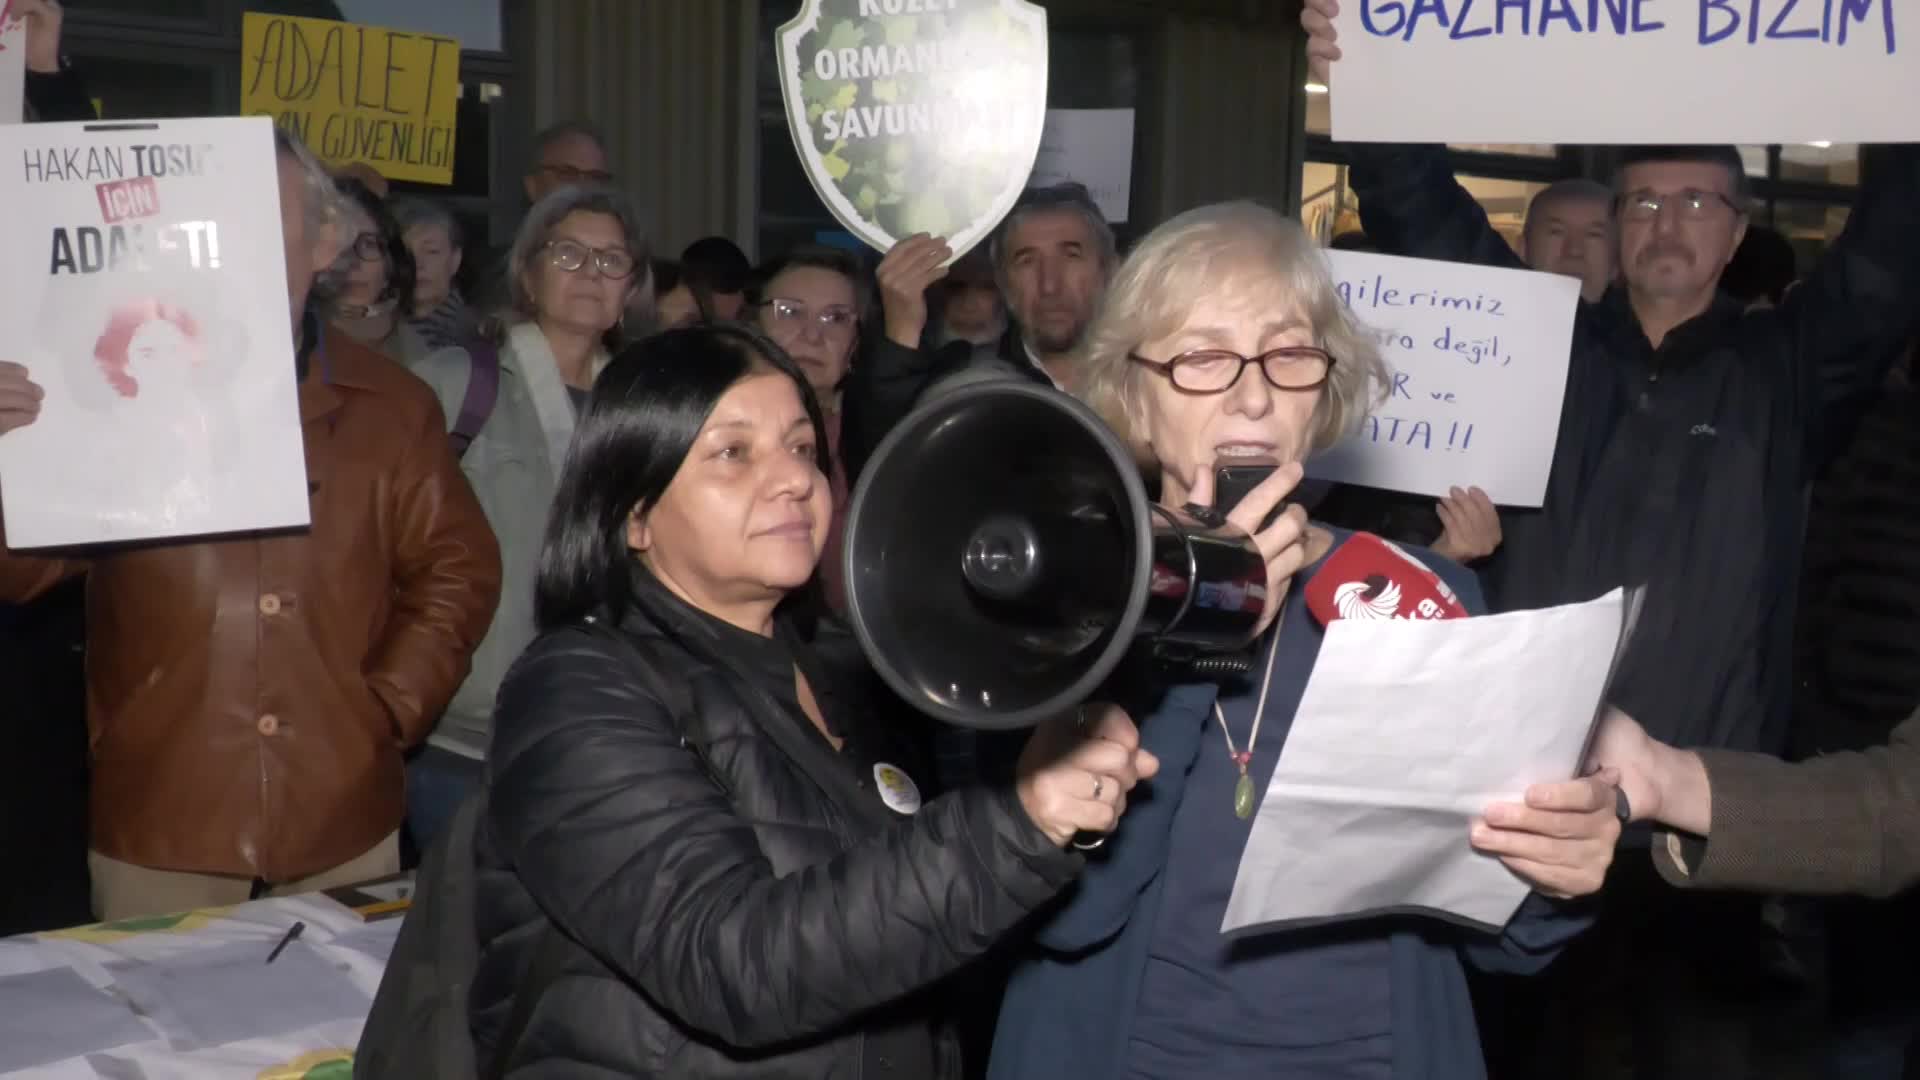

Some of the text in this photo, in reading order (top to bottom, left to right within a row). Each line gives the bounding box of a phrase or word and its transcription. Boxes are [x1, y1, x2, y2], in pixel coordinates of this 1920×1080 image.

[250, 19, 456, 118] ADALET
[23, 146, 124, 183] HAKAN
[1336, 275, 1505, 316] gilerimiz
